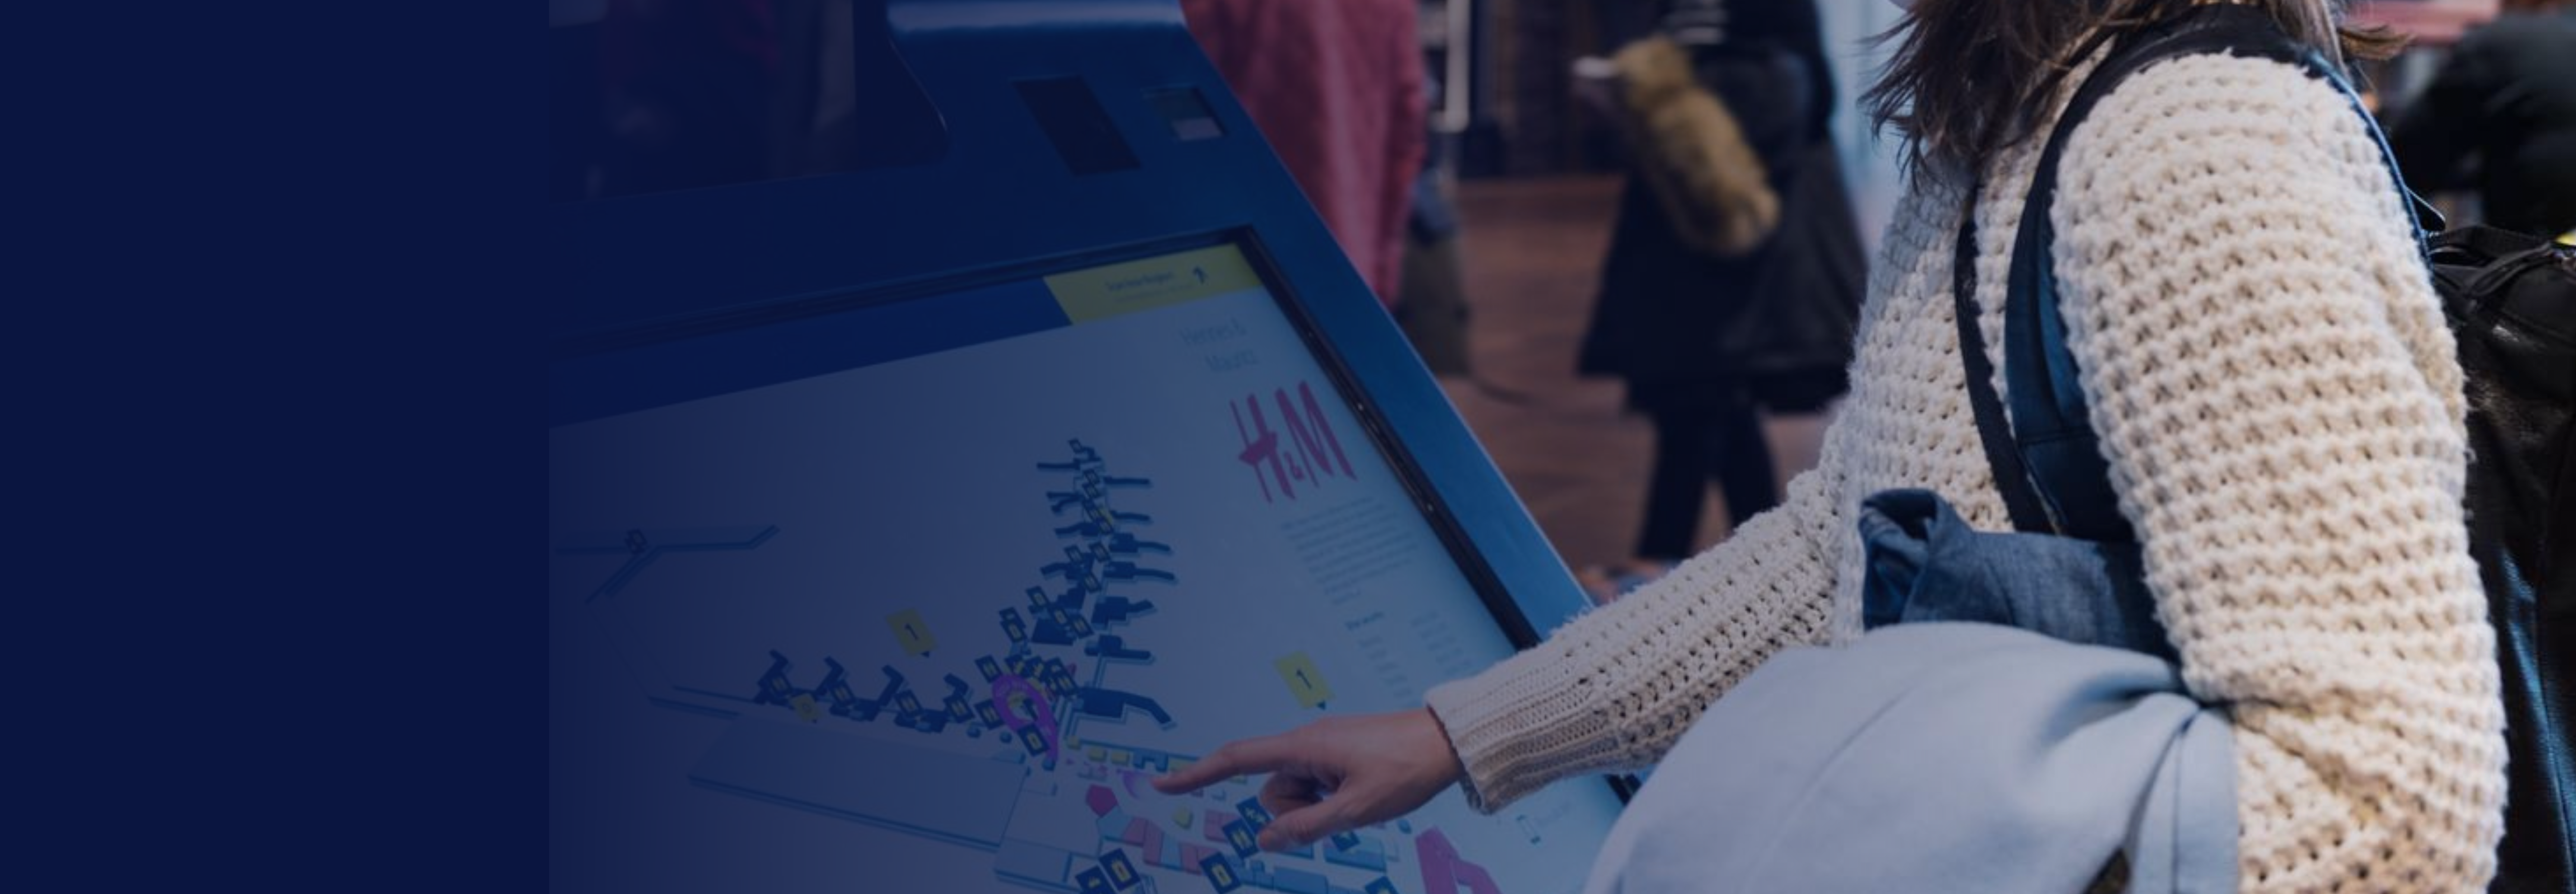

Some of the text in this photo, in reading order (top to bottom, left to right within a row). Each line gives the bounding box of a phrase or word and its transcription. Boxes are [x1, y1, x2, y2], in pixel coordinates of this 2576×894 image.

[1229, 380, 1358, 504] H&M
[905, 623, 919, 640] 1
[1297, 669, 1311, 690] 1
